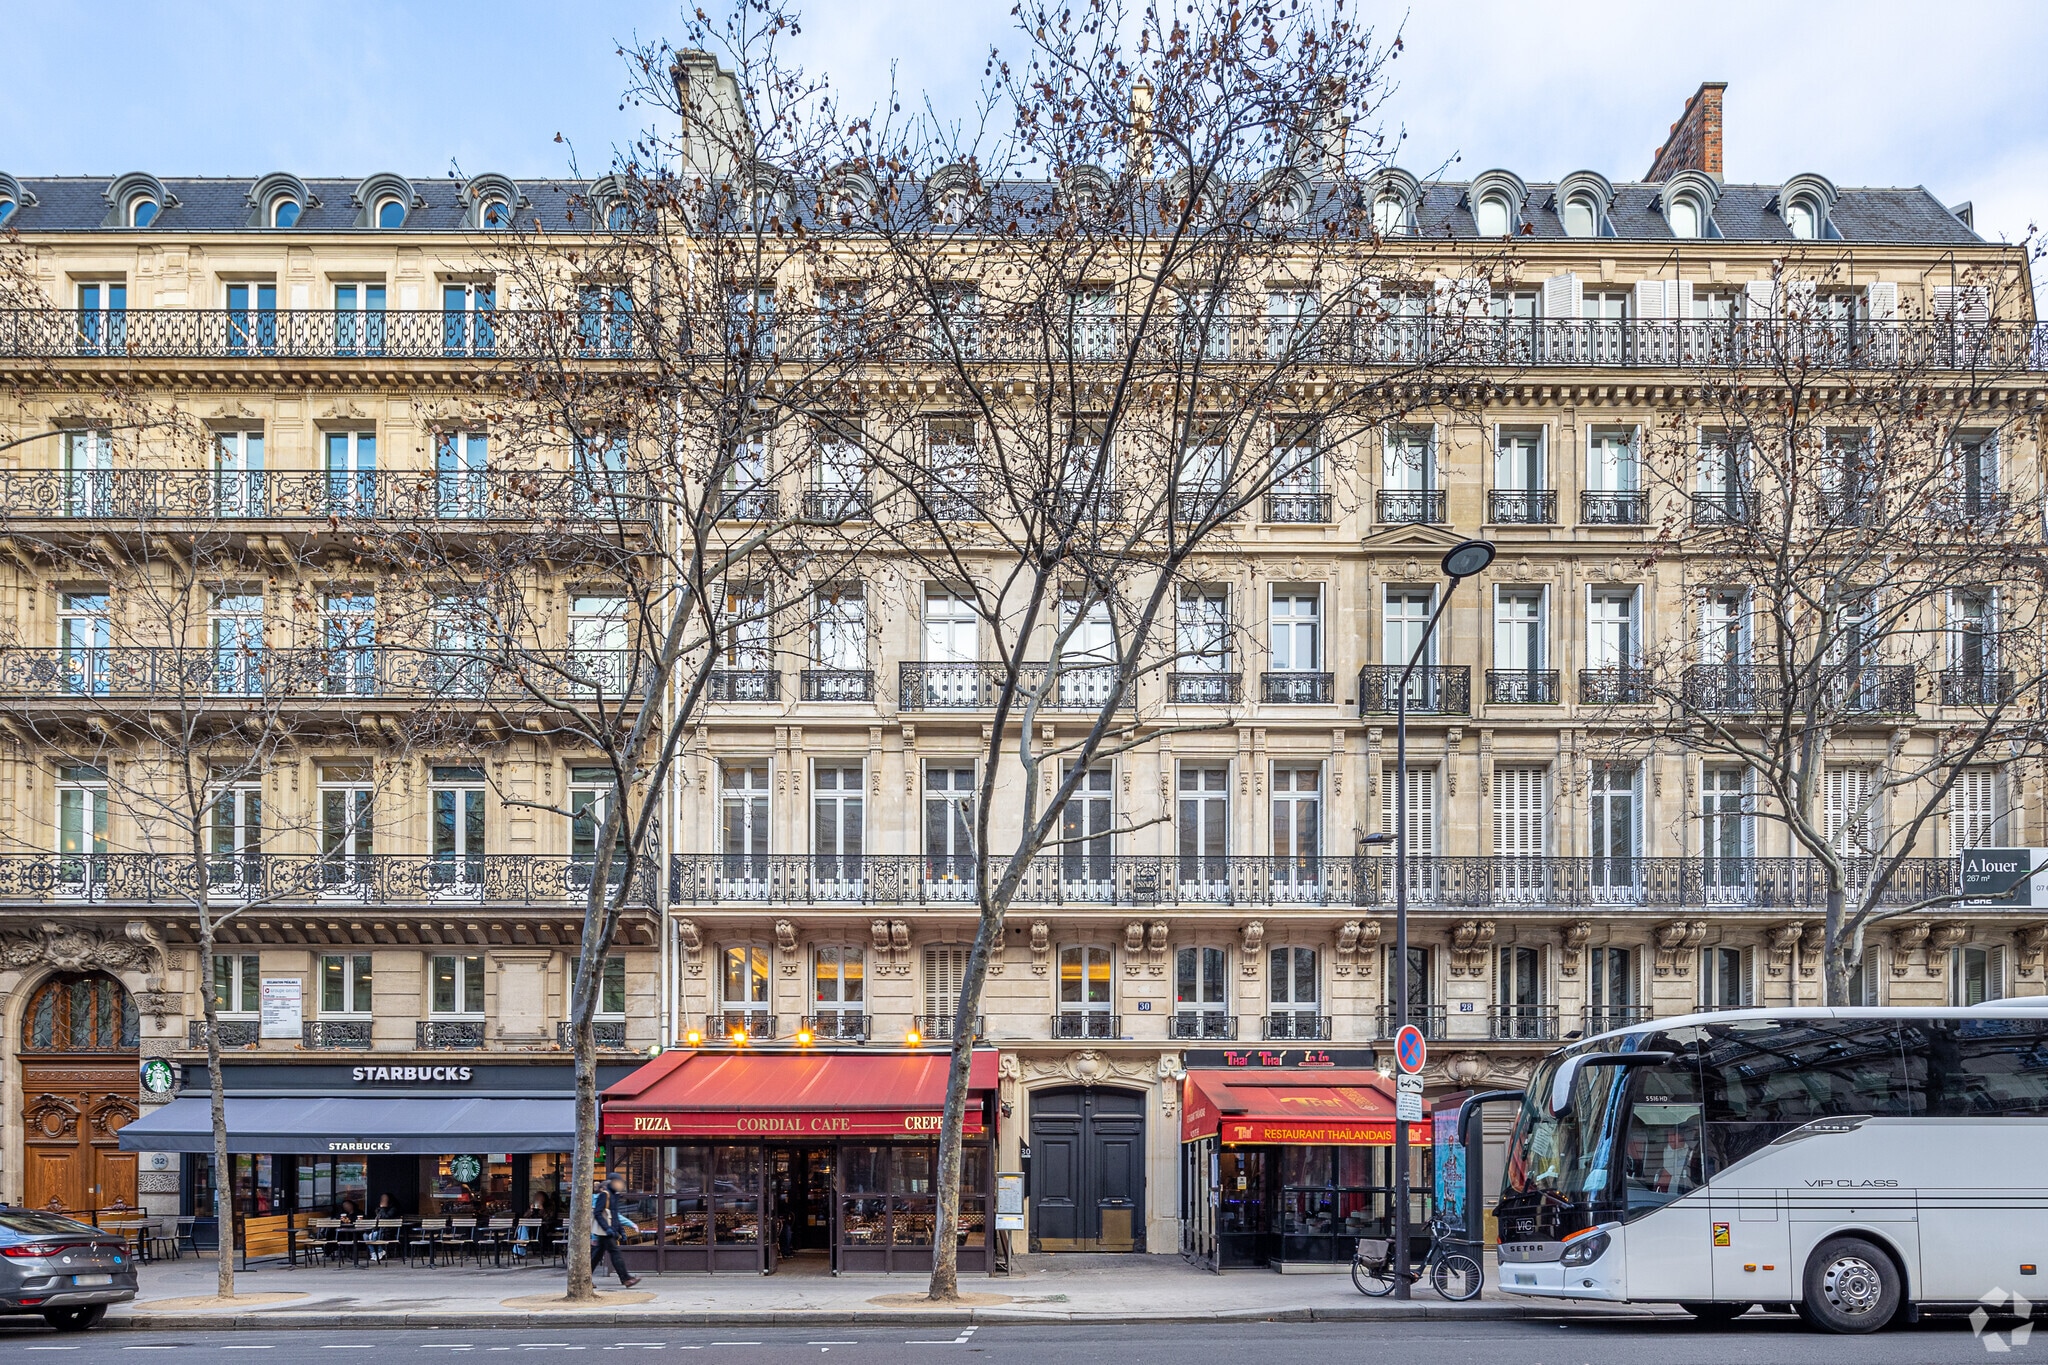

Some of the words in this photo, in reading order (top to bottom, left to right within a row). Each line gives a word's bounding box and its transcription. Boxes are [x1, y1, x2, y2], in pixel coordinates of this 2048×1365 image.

[1966, 859, 1979, 872] A
[1981, 858, 2018, 872] louer
[1966, 874, 1979, 882] 267
[1139, 1002, 1150, 1011] 30
[1461, 1002, 1472, 1011] 28
[352, 1066, 472, 1081] STARBUCKS
[634, 1117, 672, 1131] PIZZA
[737, 1117, 805, 1131] CORDIAL
[811, 1117, 850, 1131] CAFE
[1264, 1128, 1325, 1140] RESTAURANT
[1328, 1127, 1392, 1141] THAÏLANDAIS
[328, 1142, 391, 1151] STARBUCKS
[154, 1157, 165, 1165] 32
[1804, 1179, 1833, 1188] VIP
[1836, 1179, 1899, 1188] CLASS
[1517, 1220, 1532, 1231] VIC
[1510, 1244, 1544, 1252] SETRA
